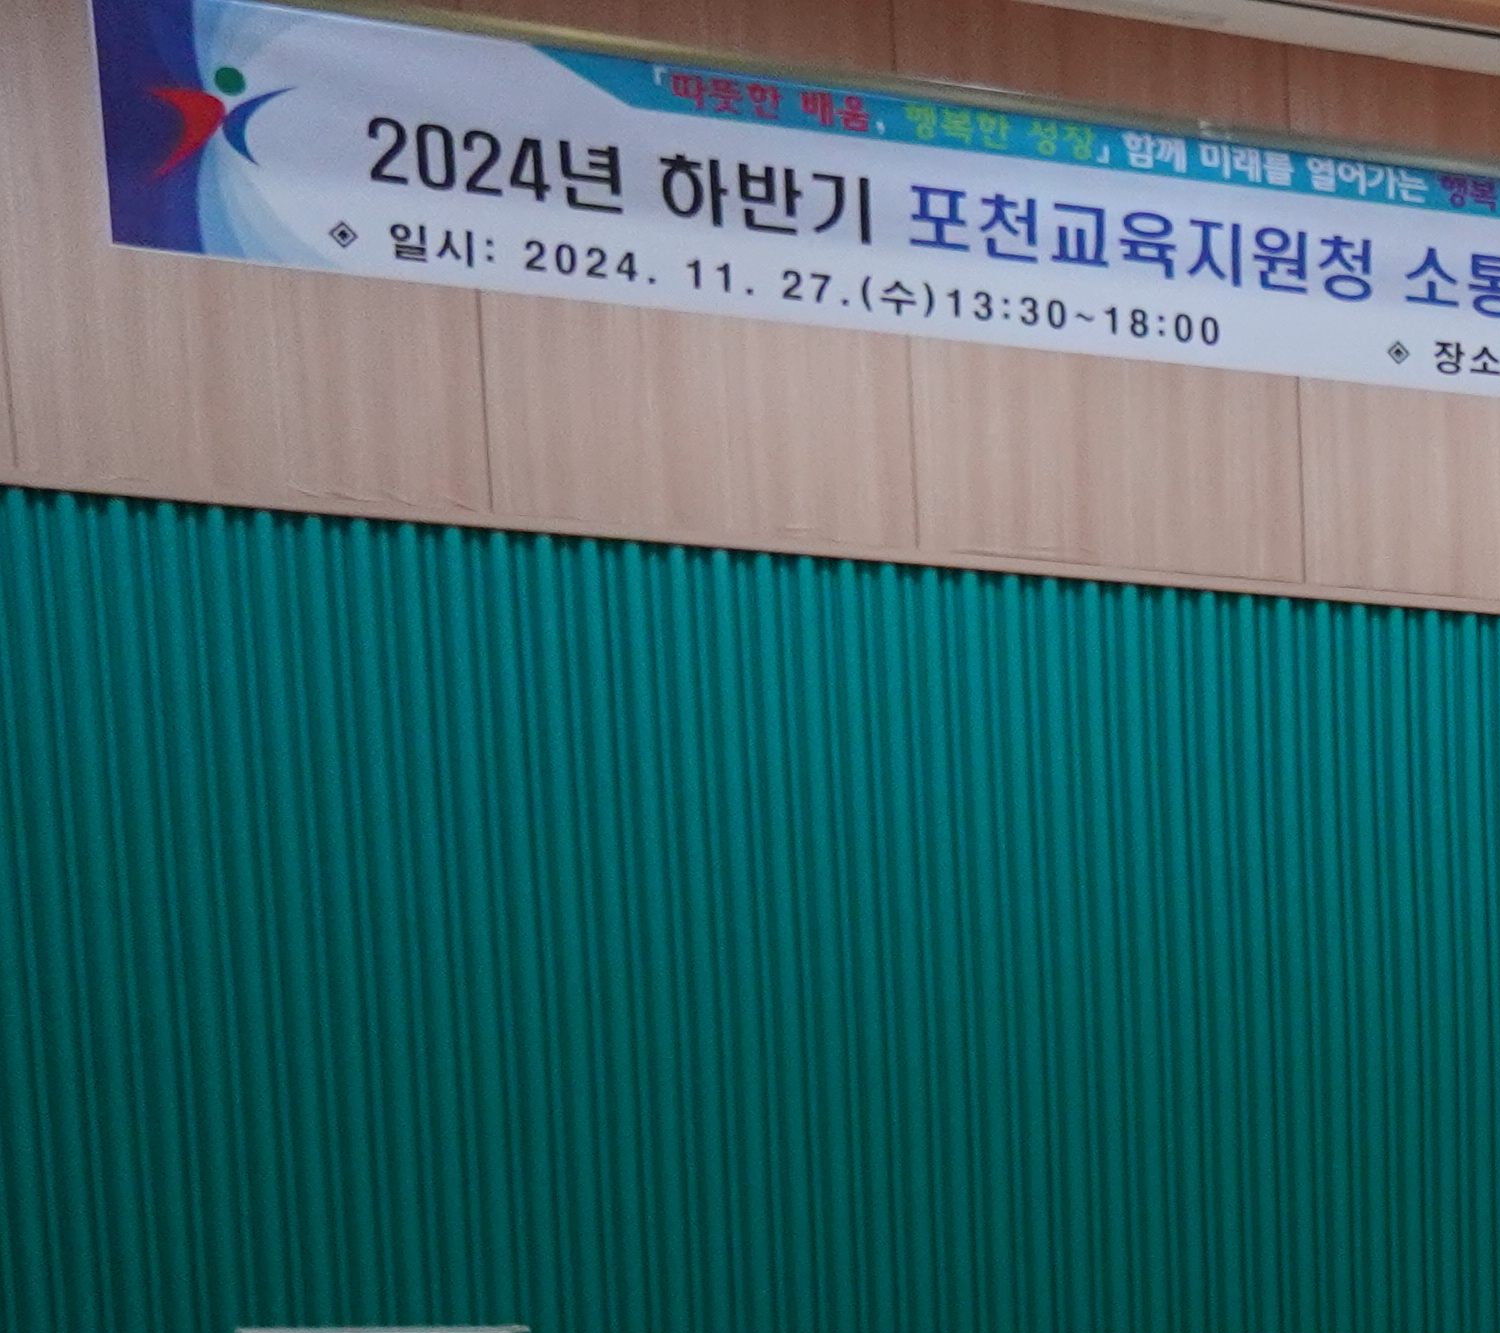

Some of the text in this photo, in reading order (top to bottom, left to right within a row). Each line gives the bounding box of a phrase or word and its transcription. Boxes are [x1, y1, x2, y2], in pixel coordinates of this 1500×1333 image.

[367, 116, 624, 214] 2024년
[660, 153, 872, 246] 하반기
[909, 183, 1373, 303] 포천교육지원청
[904, 103, 1009, 150] 행복한
[1121, 131, 1188, 174] 함께
[1199, 142, 1295, 186] 미래를
[1306, 156, 1429, 204] 열어가는
[1436, 173, 1498, 213] 행복
[388, 222, 495, 268] 일시:
[524, 240, 657, 285] 2024.
[686, 258, 755, 296] 11.
